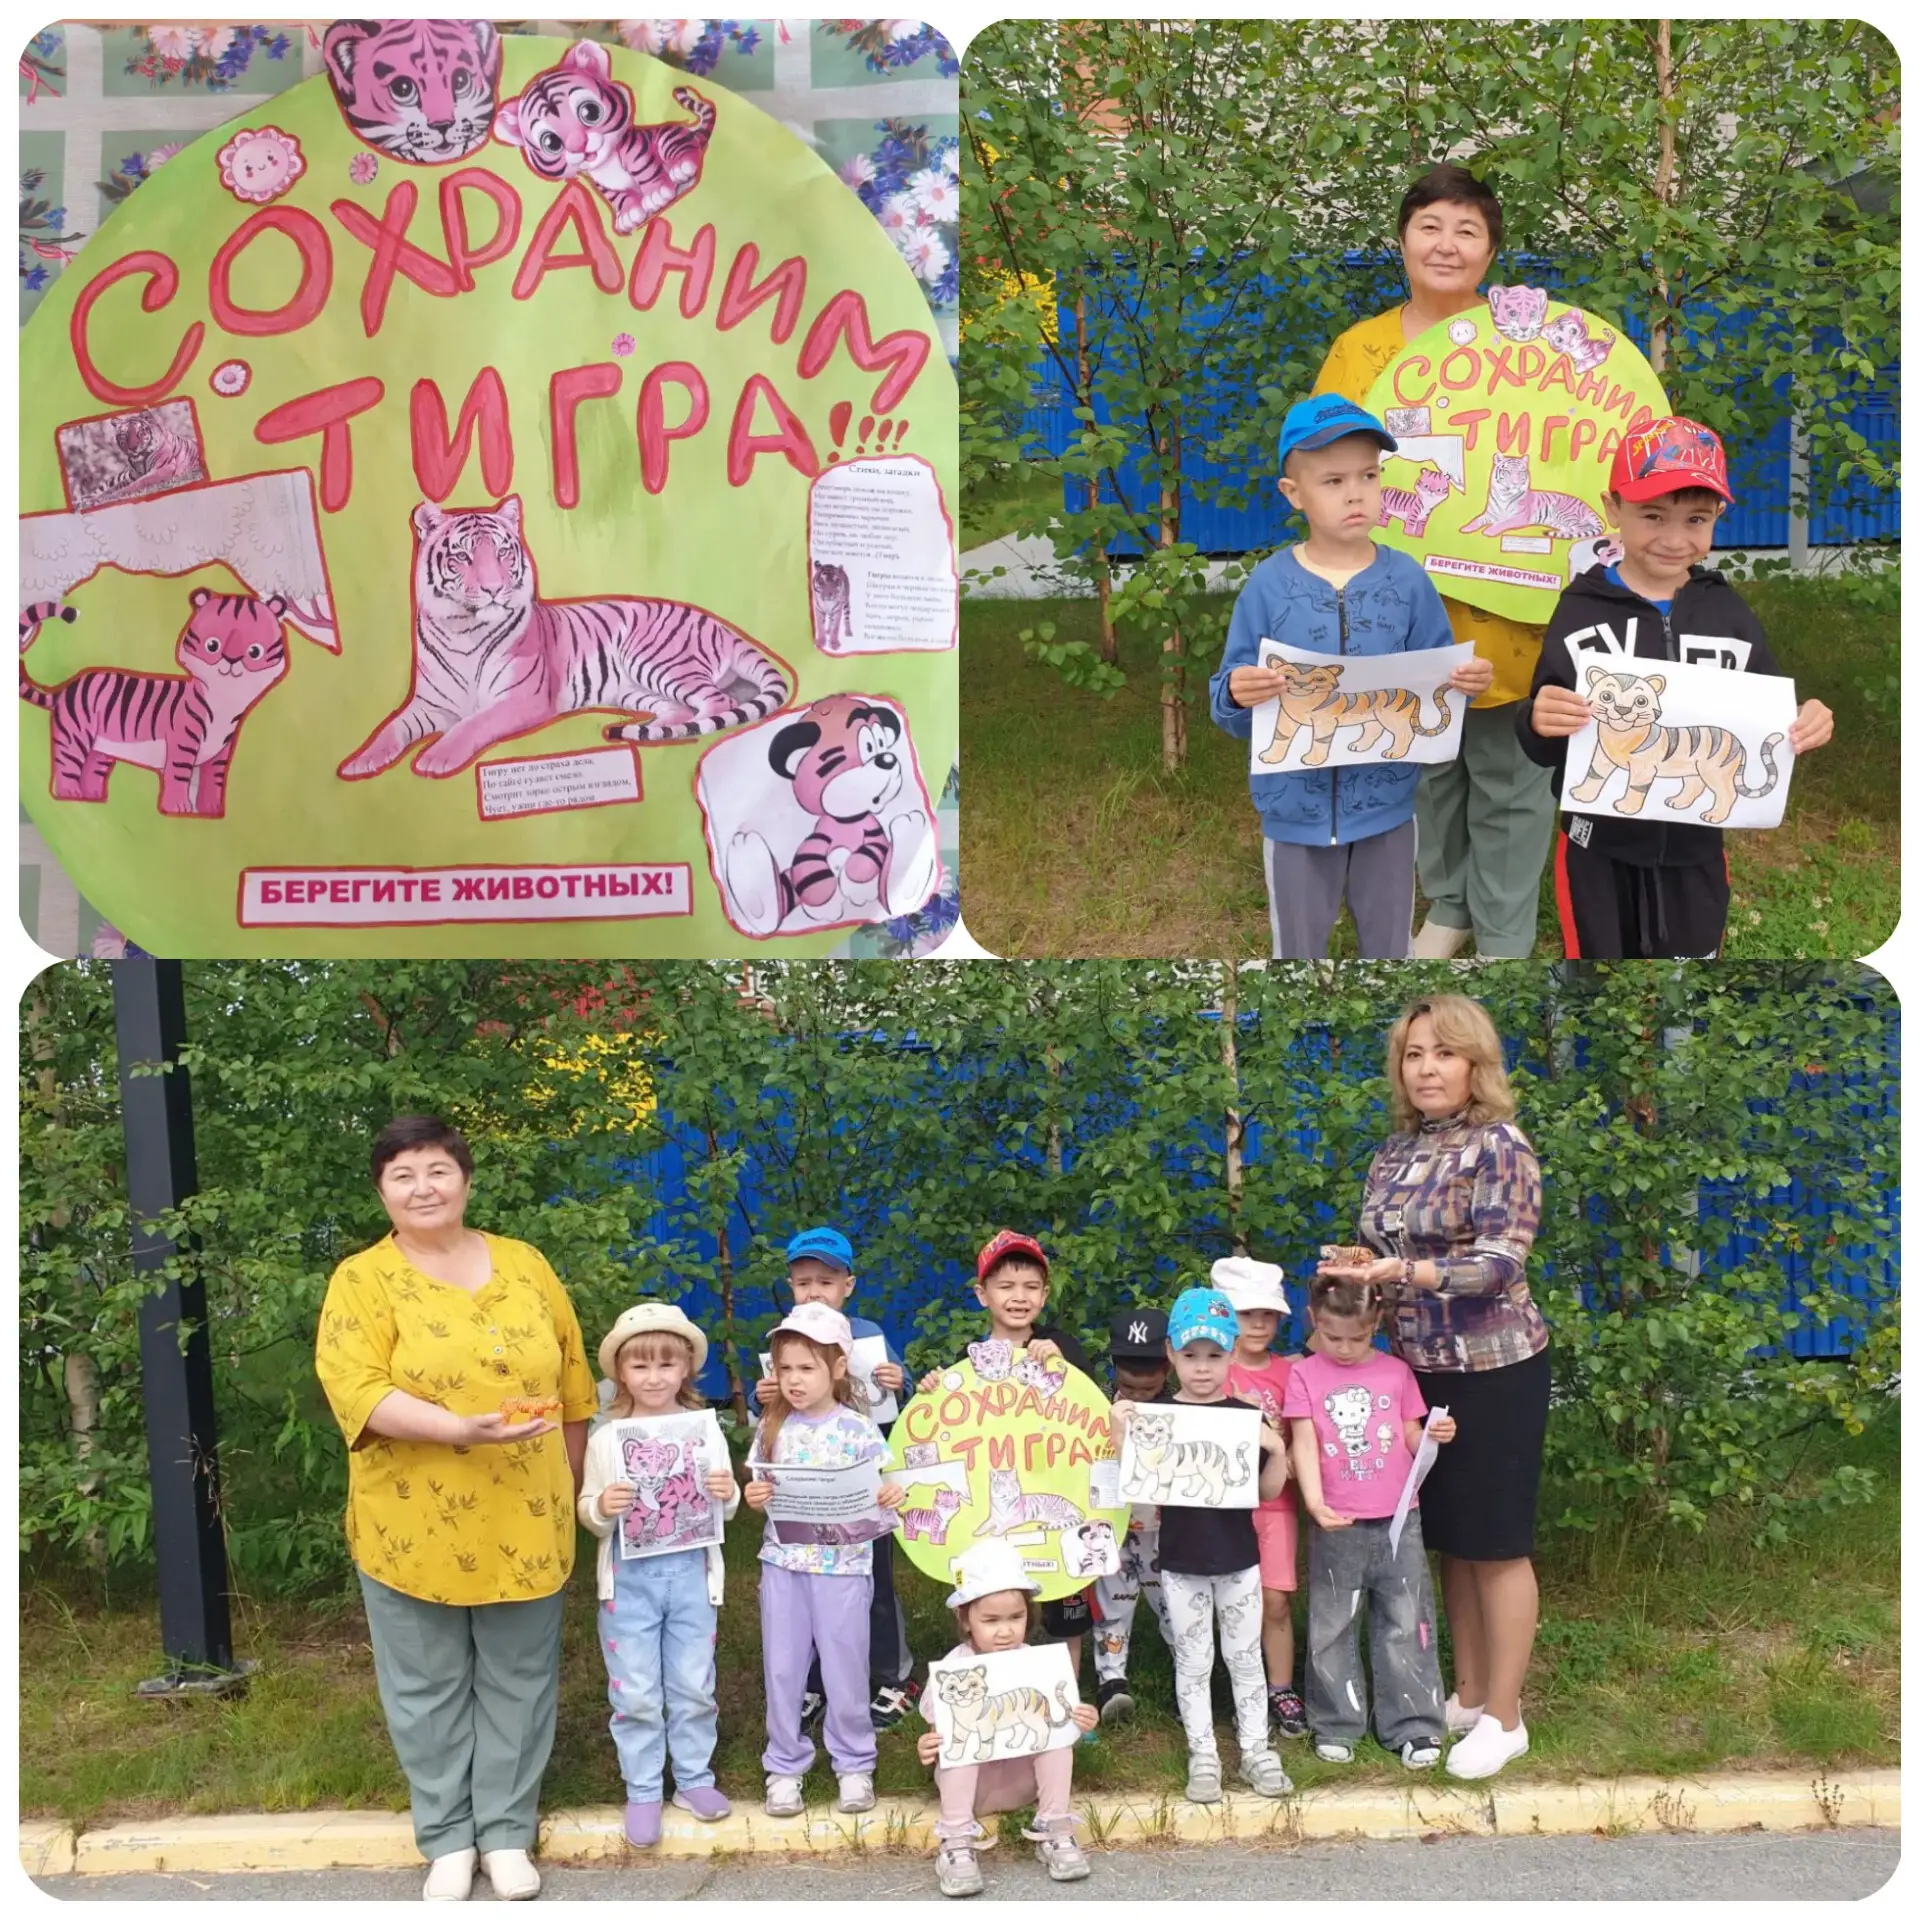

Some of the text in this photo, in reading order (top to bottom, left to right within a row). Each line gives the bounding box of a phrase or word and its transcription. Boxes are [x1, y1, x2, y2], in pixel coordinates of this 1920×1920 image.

[70, 166, 931, 415] СОХРАНИМ
[1430, 558, 1557, 584] БЕРЕГИТЕ ЖИВОТНЫХ!
[541, 760, 571, 772] страха
[259, 872, 675, 905] БЕРЕГИТЕ ЖИВОТНЫХ!
